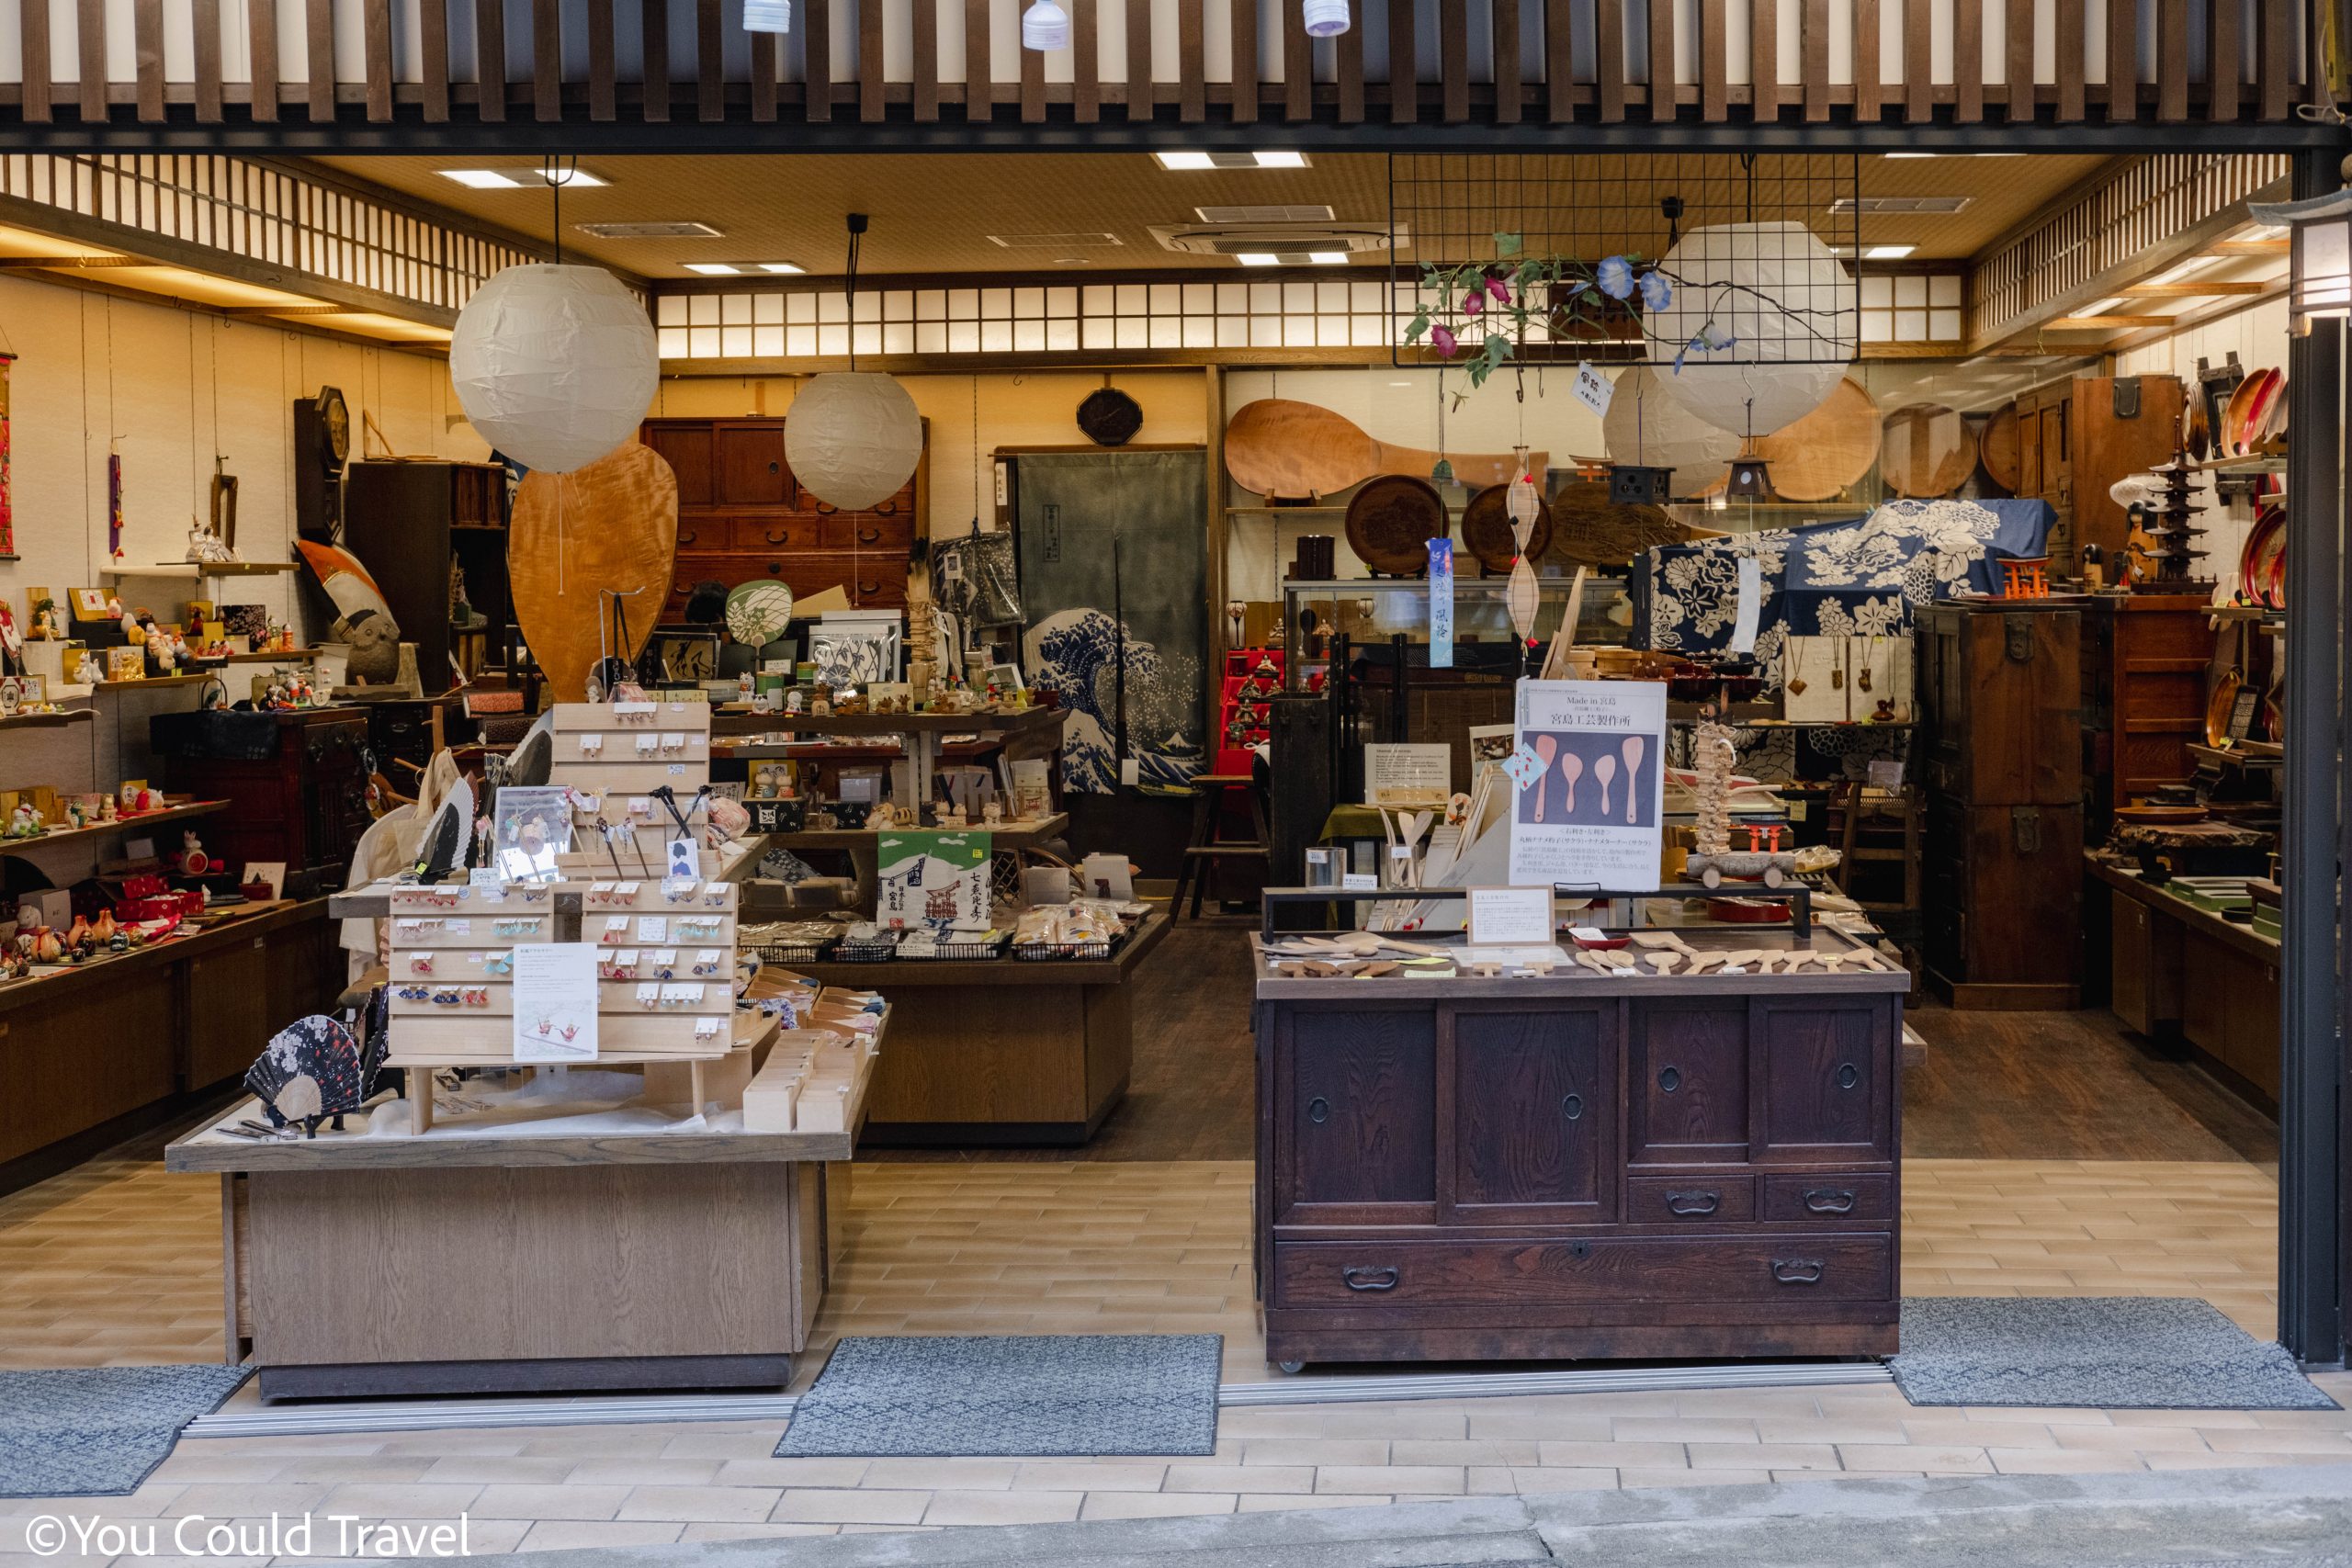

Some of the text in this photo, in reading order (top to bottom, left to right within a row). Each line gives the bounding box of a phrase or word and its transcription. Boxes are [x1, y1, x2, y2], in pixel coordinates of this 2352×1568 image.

[1590, 696, 1598, 705] in
[1600, 697, 1616, 705] 宮島
[1551, 714, 1631, 727] 宮島工芸製作所
[888, 891, 898, 911] 宮島
